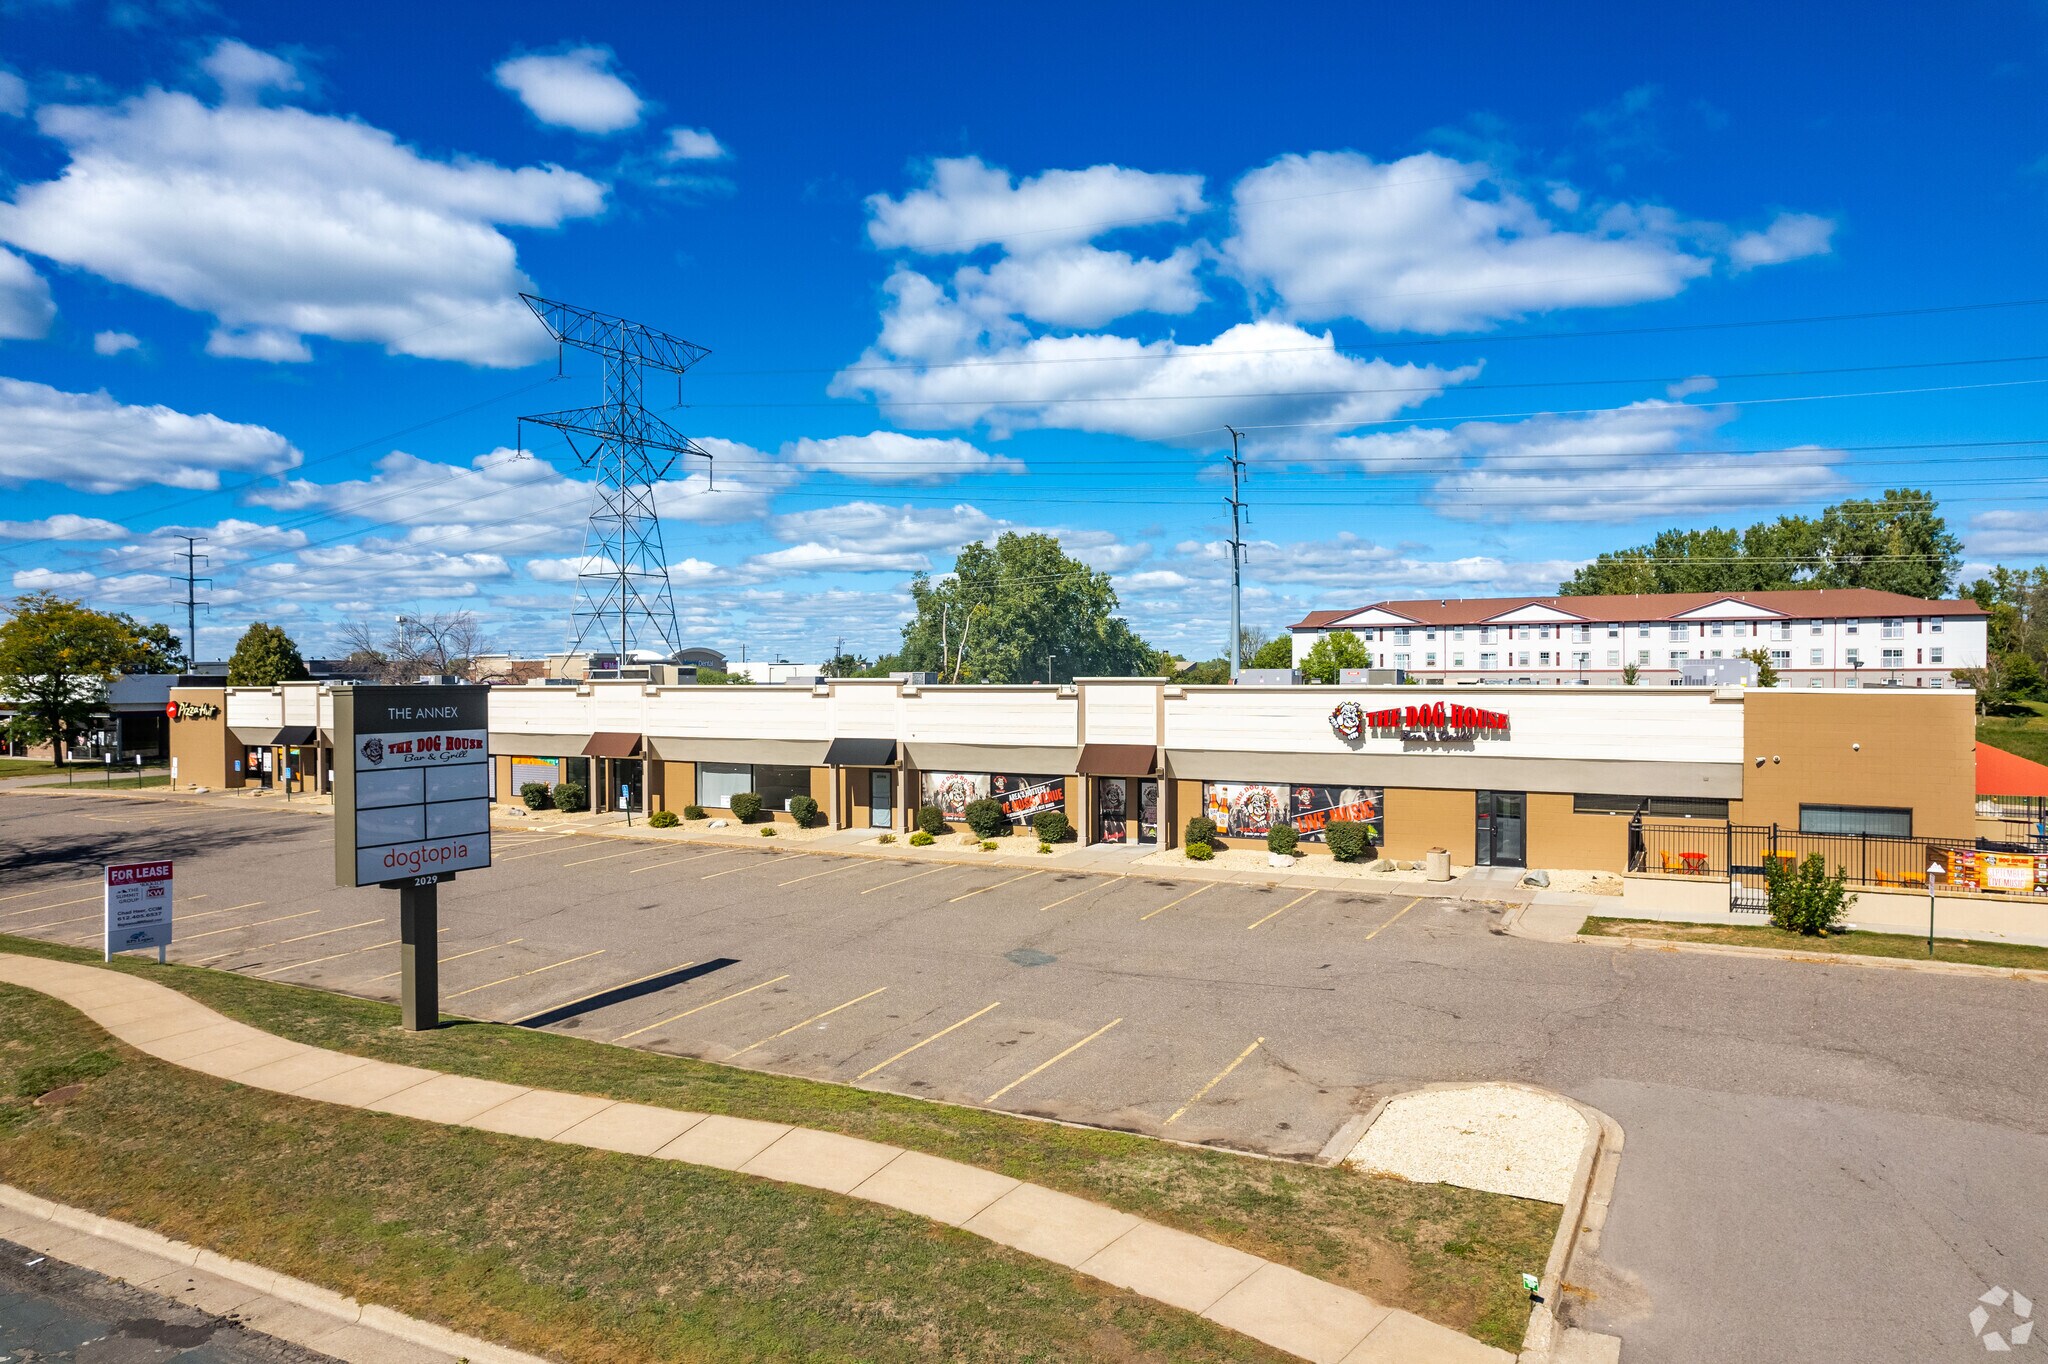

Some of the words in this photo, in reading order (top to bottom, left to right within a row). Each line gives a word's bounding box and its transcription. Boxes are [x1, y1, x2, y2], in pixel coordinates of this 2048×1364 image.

[178, 702, 199, 717] Pizza
[199, 704, 216, 716] Hut
[388, 707, 412, 720] THE
[415, 707, 458, 719] ANNEX
[1366, 708, 1401, 728] THE
[1405, 701, 1446, 728] DOG
[1450, 703, 1509, 729] HOUSE
[1400, 730, 1424, 742] Bar
[1438, 730, 1473, 742] Grill
[388, 741, 412, 754] THE
[417, 735, 441, 752] DOG
[446, 736, 483, 751] HOUSE
[404, 753, 425, 762] Bar
[440, 750, 468, 762] Grill
[1039, 788, 1064, 804] VENUE
[1235, 791, 1245, 806] THE
[1244, 784, 1259, 793] DOG
[1296, 811, 1326, 833] LIVE
[1329, 800, 1375, 822] MUSIC
[383, 841, 468, 874] dogtopia
[111, 869, 134, 880] FOR
[136, 865, 169, 878] LEASE
[414, 875, 438, 887] 2029
[1988, 878, 2003, 886] LIVE
[2003, 878, 2025, 888] MUSIC
